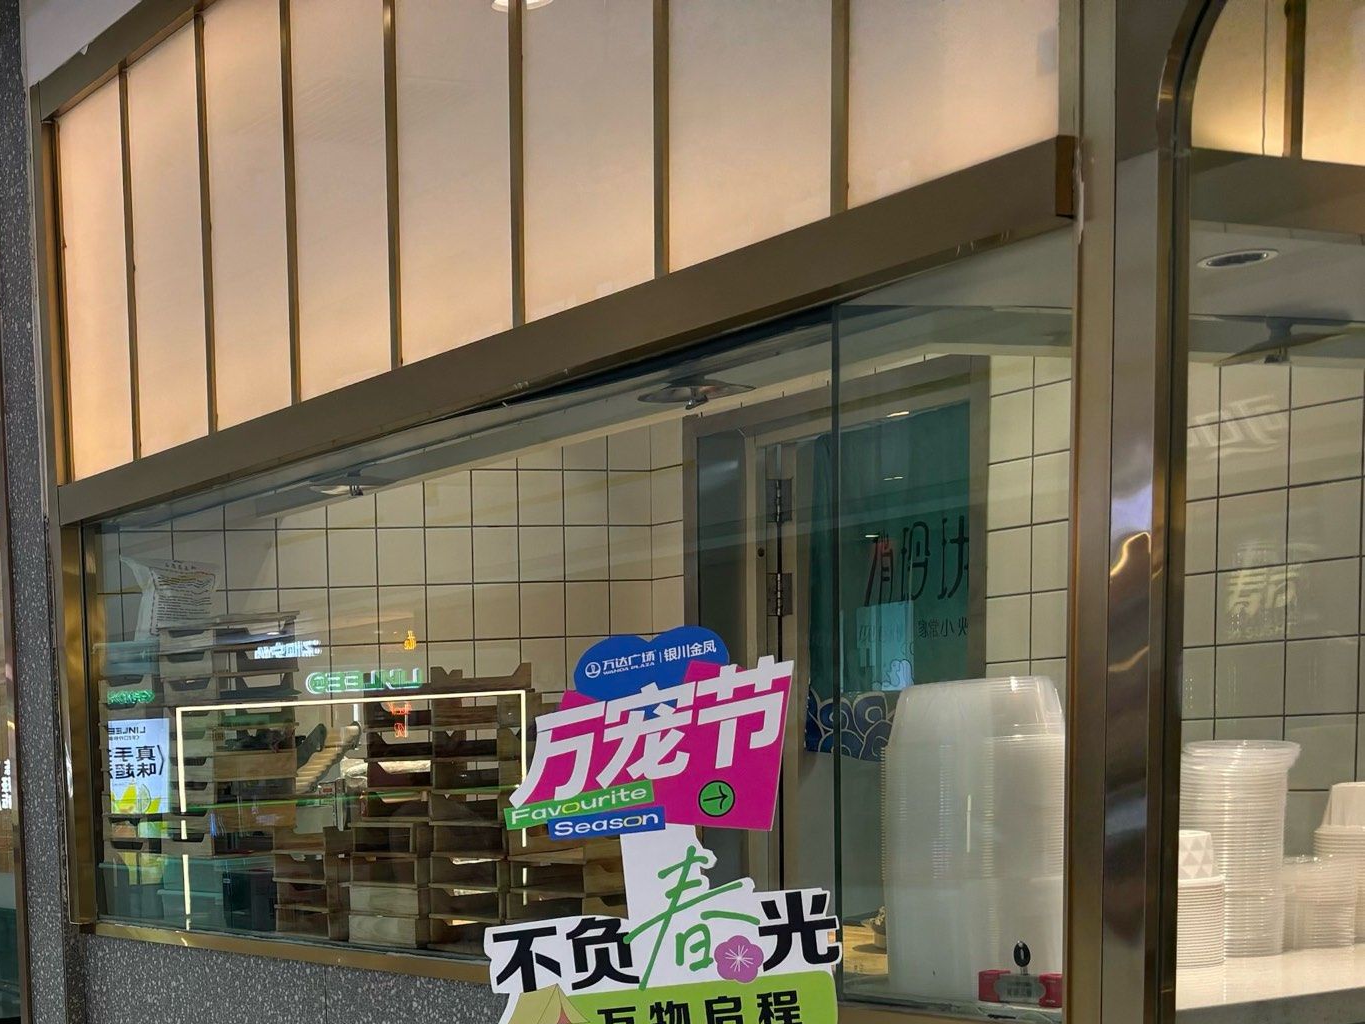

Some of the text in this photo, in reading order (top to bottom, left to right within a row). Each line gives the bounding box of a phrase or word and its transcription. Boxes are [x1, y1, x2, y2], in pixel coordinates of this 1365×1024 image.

[602, 640, 717, 671] 万达广场 银川金凤
[510, 656, 795, 808] 万宠节
[510, 787, 649, 824] Favourite
[554, 811, 660, 837] Season
[491, 846, 840, 992] 不负春光
